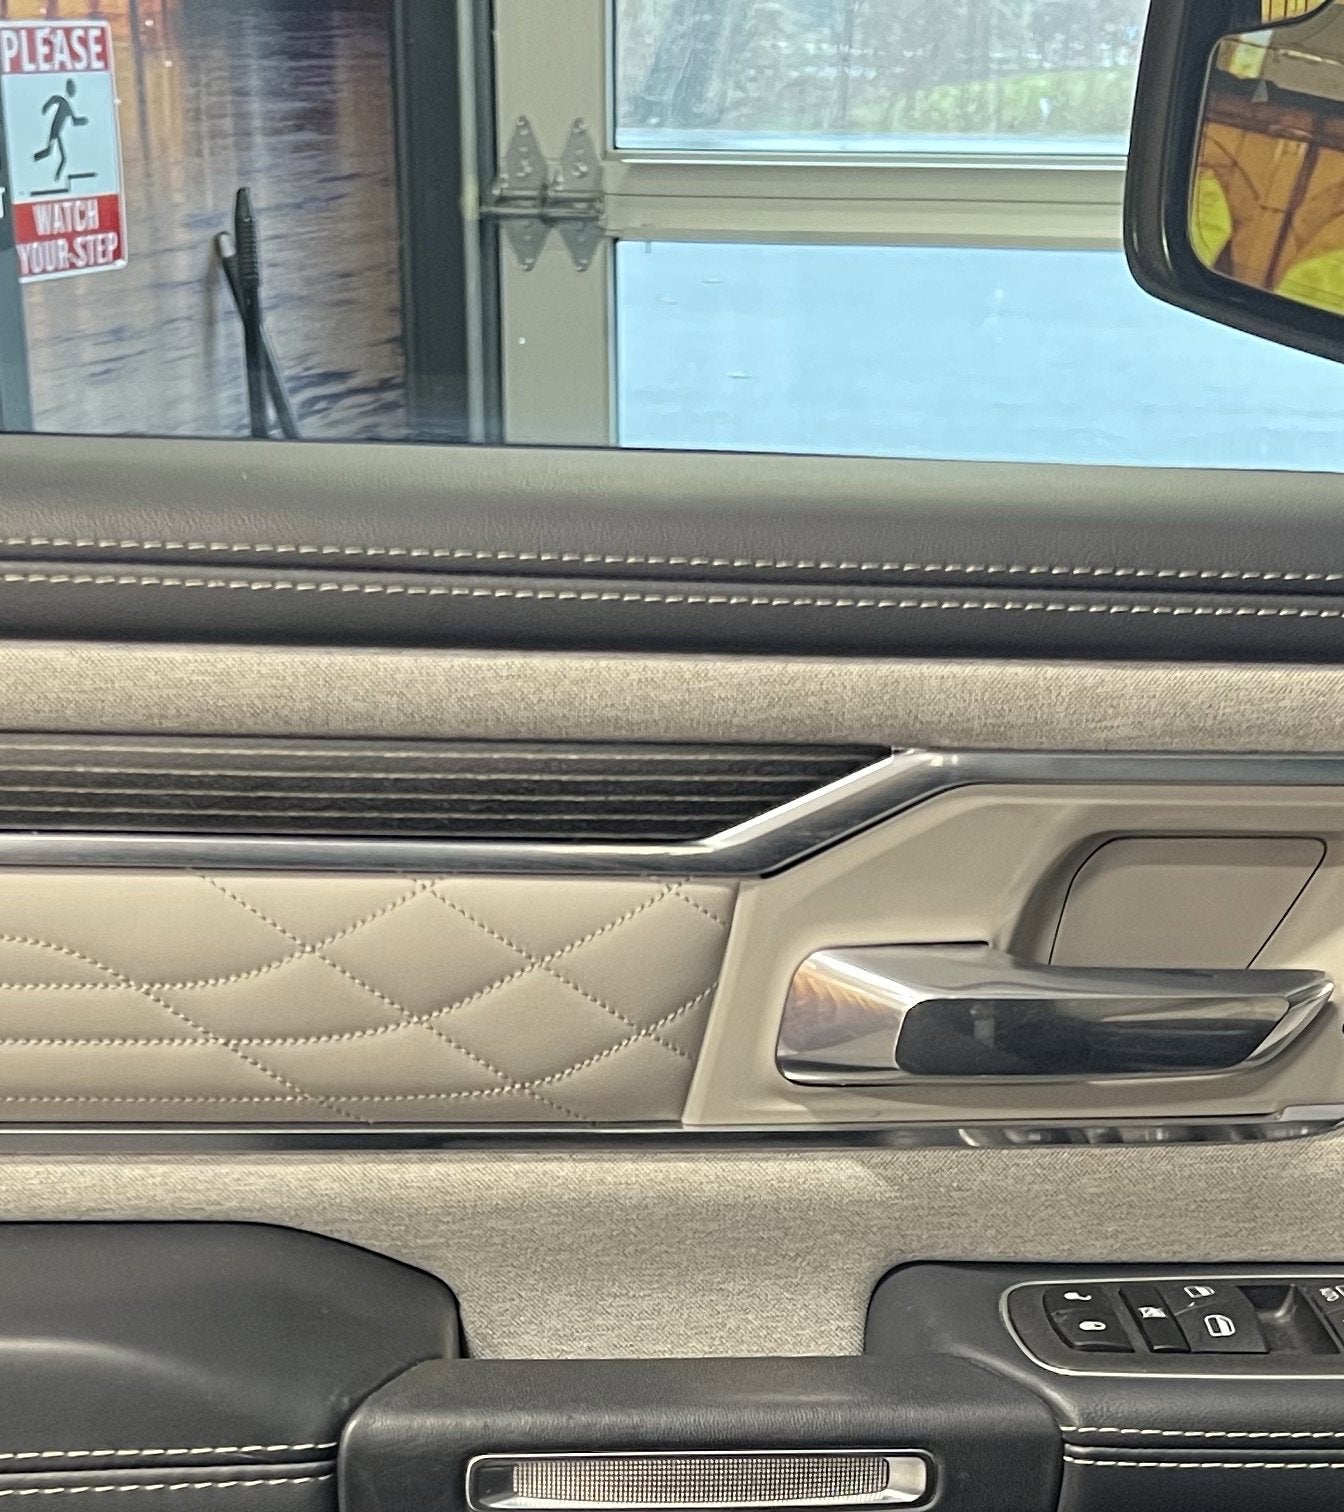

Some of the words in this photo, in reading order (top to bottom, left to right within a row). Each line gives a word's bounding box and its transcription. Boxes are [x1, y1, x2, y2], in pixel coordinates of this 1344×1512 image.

[0, 27, 105, 72] PLEASE
[32, 198, 99, 236] WATCH
[16, 238, 70, 275] YOUR
[72, 232, 119, 268] STEP
